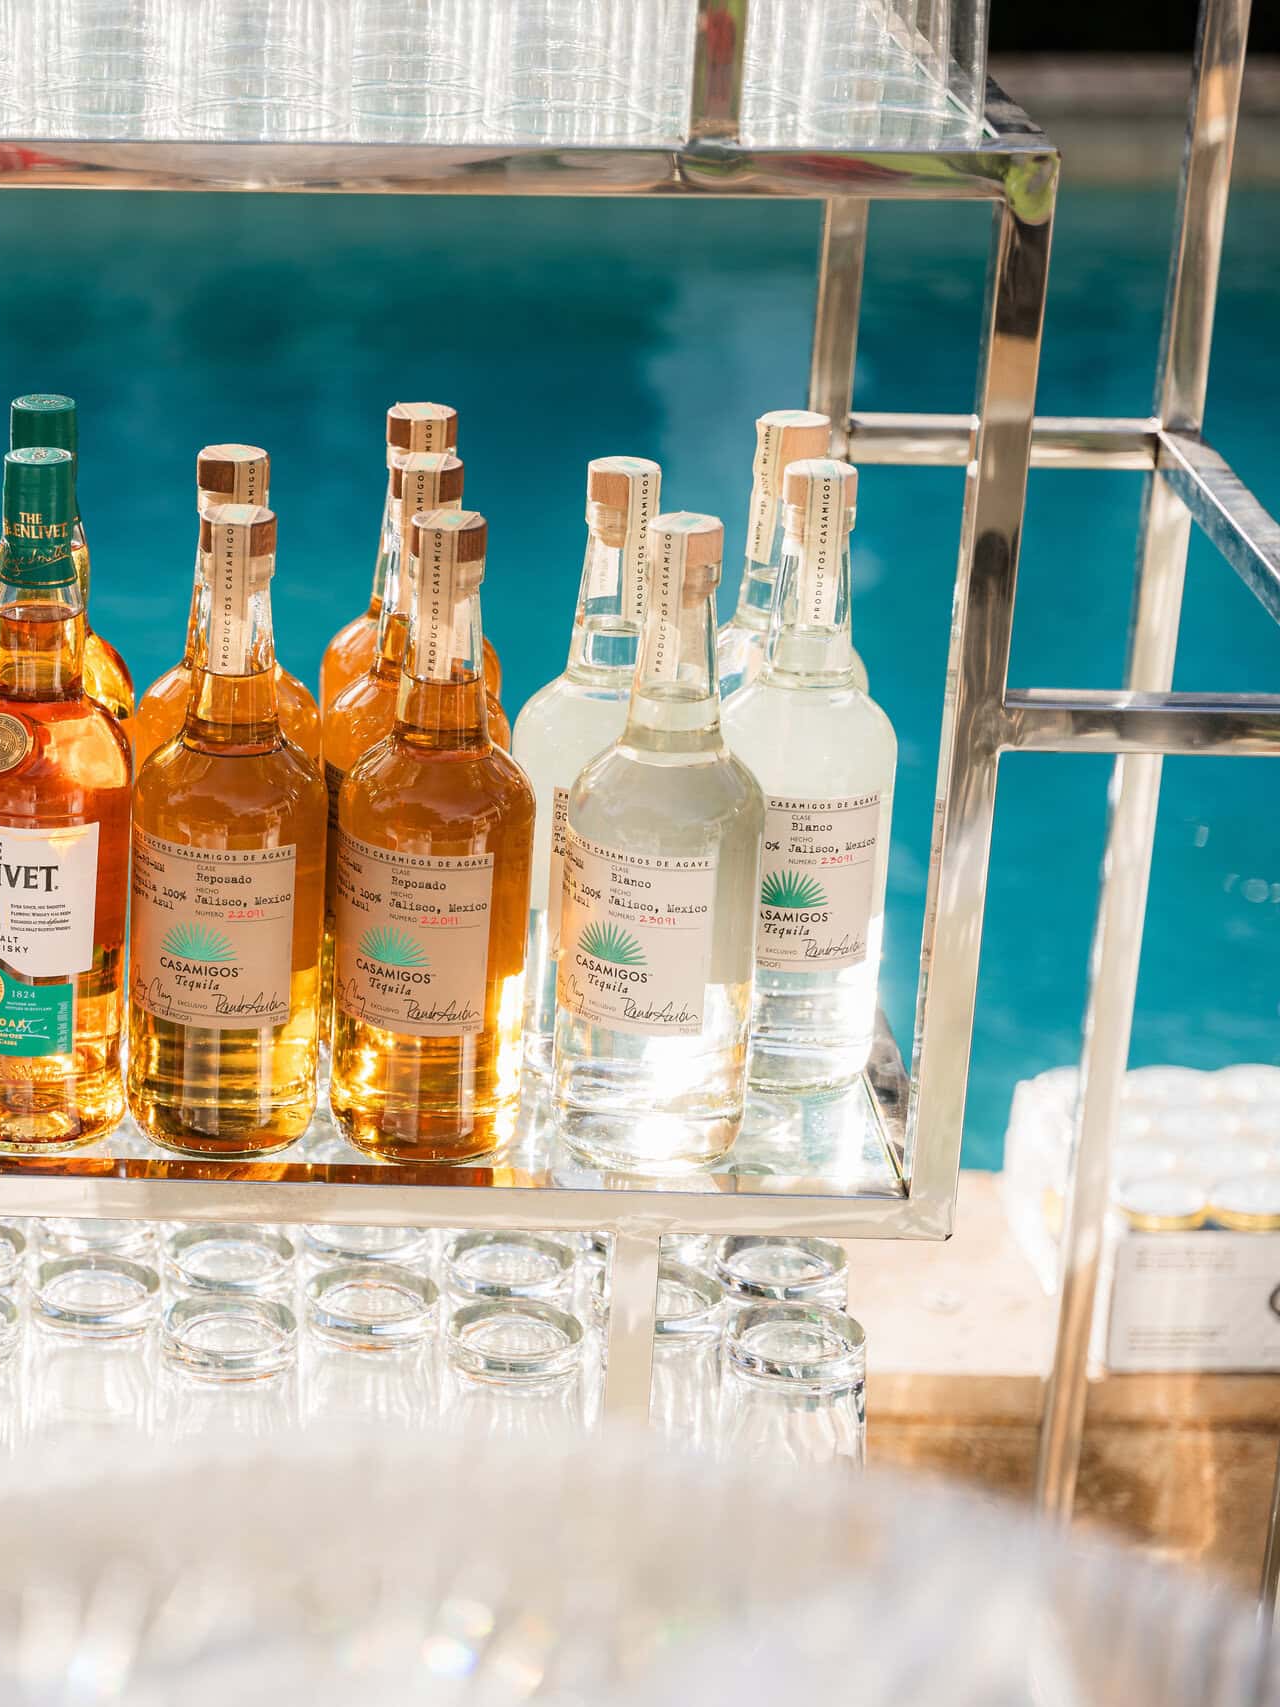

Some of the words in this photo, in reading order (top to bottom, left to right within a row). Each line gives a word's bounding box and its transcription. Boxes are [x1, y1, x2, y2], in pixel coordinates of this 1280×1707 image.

[19, 512, 42, 524] THE
[636, 545, 644, 614] PRODUCTOS
[640, 473, 649, 539] CASAMIGOS
[814, 551, 826, 619] PRODUCTOS
[820, 477, 831, 543] CASAMIGOS
[225, 523, 234, 589] CASAMIGO
[222, 597, 232, 666] PRODUCTOS
[429, 601, 439, 672] PRODUCTOS
[655, 602, 668, 672] PRODUCTOS
[771, 800, 831, 810] CASAMIGOS
[838, 801, 848, 809] DE
[854, 795, 878, 807] AGAVE
[792, 823, 833, 832] Blanco
[845, 837, 876, 851] Mexico
[177, 848, 236, 862] CASAMIGOS
[262, 850, 291, 860] AGAVE
[374, 851, 431, 867] CASAMIGOS
[457, 859, 489, 867] AGAVE
[594, 847, 650, 866] CASAMIGOS
[657, 859, 668, 868] DE
[196, 872, 252, 885] Reposado
[392, 876, 447, 891] Reposado
[611, 873, 652, 889] Blanco
[163, 887, 187, 901] 100%
[255, 893, 291, 905] Mexico
[360, 888, 381, 903] 100%
[581, 884, 601, 900] 100%
[449, 902, 487, 913] Mexico
[667, 904, 708, 914] Mexico
[760, 910, 829, 923] SAMIGOS
[764, 923, 810, 938] Tequila
[160, 957, 238, 977] CASAMIGOS
[356, 958, 431, 984] CASAMIGOS
[575, 954, 648, 983] CASAMIGOS
[175, 975, 220, 991] Tequila
[369, 977, 412, 996] Tequila
[588, 973, 629, 994] Tequila
[11, 990, 36, 999] 1824
